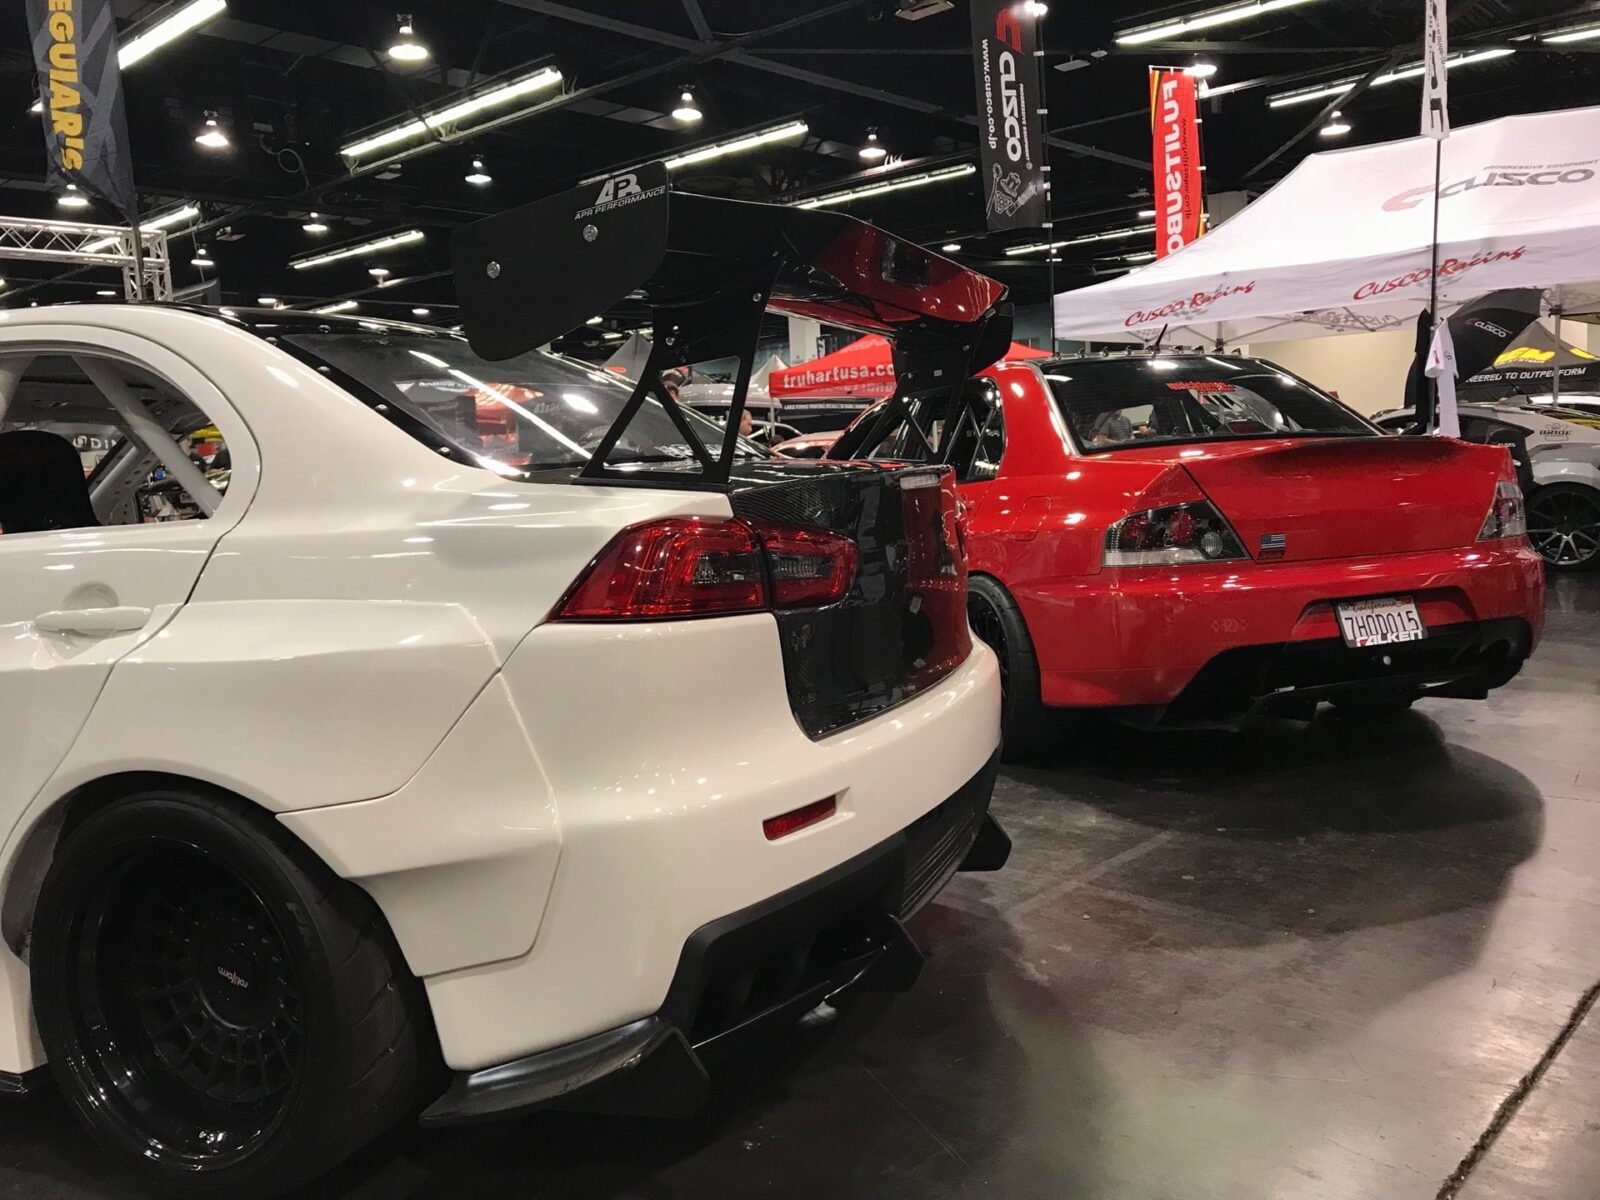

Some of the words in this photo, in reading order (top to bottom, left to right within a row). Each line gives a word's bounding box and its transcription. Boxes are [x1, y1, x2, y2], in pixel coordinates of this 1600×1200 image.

[981, 38, 999, 149] www.cusco.co.jp
[998, 51, 1022, 162] CUSCO
[1437, 168, 1596, 199] CUSCO
[574, 208, 594, 221] APR
[594, 186, 666, 215] PERFORMANCE
[1474, 321, 1507, 338] CUSCO
[1519, 367, 1587, 379] OUTPEFORM
[1356, 629, 1423, 648] FALKEN
